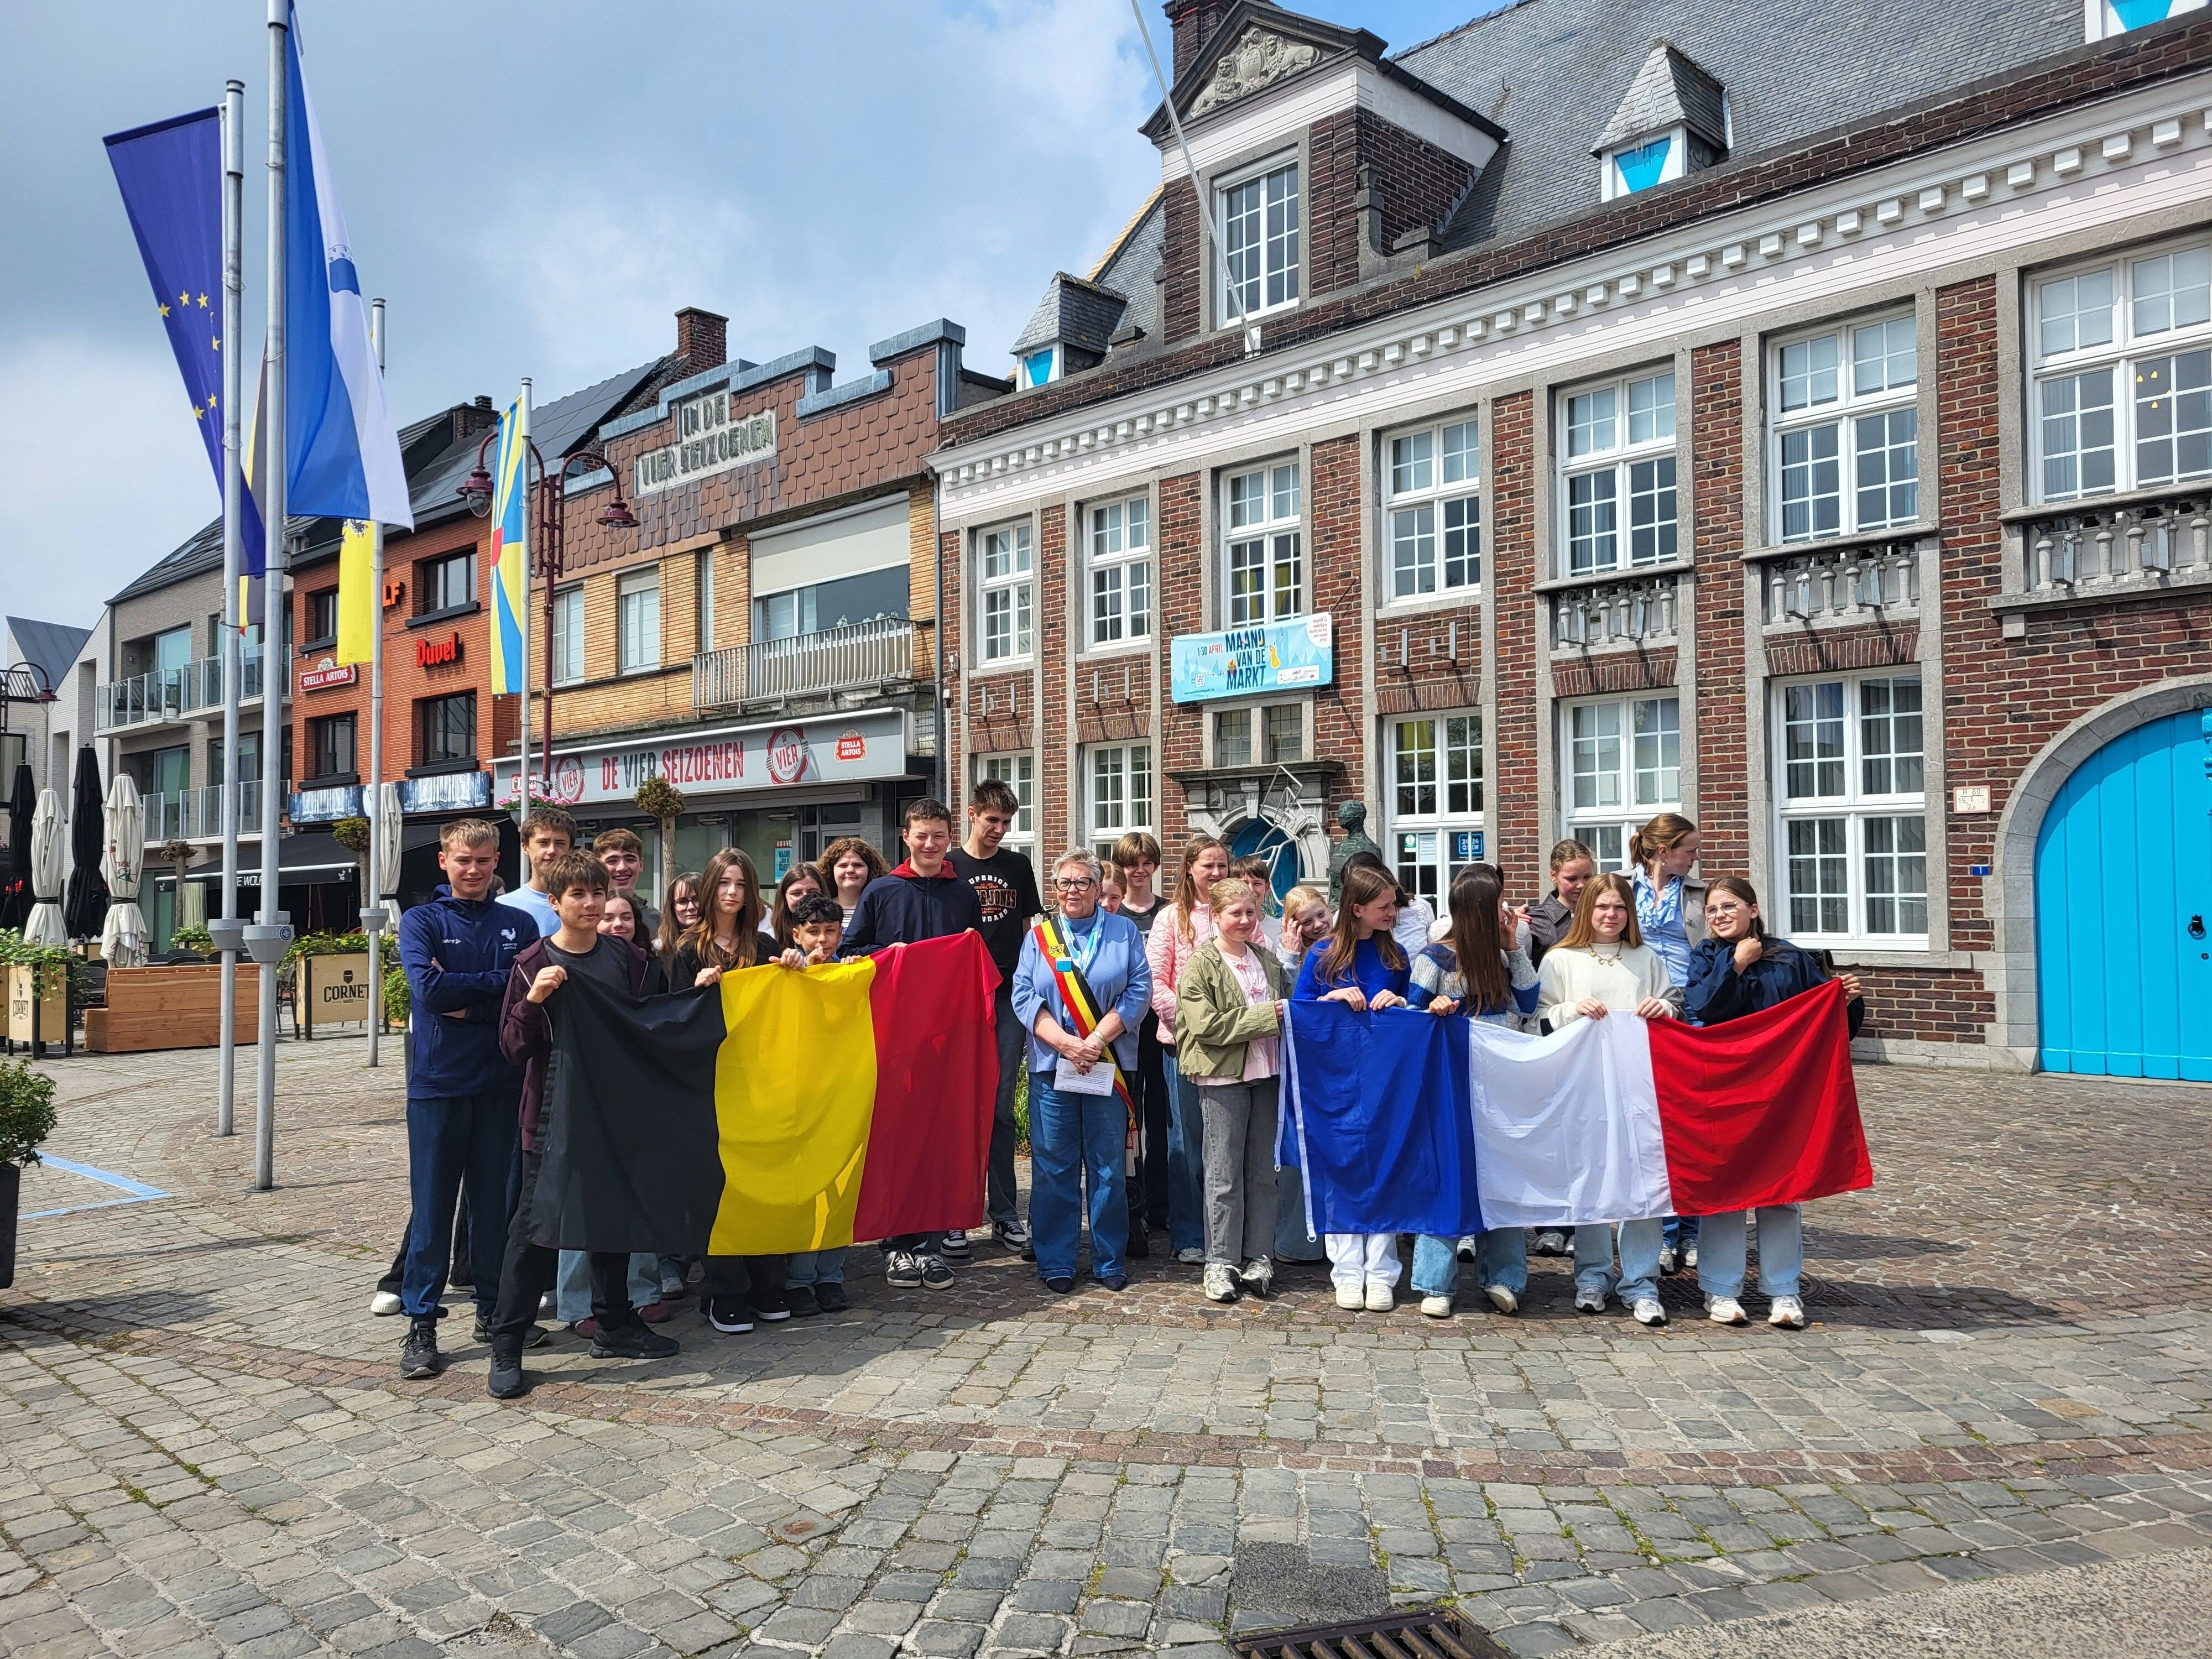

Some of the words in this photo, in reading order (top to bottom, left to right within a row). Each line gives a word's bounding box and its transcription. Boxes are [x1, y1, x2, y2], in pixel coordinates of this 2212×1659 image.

[684, 403, 701, 436] IN
[703, 394, 726, 429] DE
[641, 449, 677, 486] VIER
[680, 415, 774, 474] SEIZOENEN
[382, 581, 400, 607] LF
[416, 632, 456, 667] Duvel
[1197, 646, 1207, 656] 1-30
[1208, 644, 1223, 654] APRIL
[1225, 628, 1265, 653] MAAND
[1236, 649, 1253, 667] VAN
[1255, 649, 1266, 665] DE
[303, 674, 325, 686] STELLA
[326, 669, 348, 682] ARTOIS
[1226, 665, 1266, 691] MARKT
[782, 733, 787, 744] DE
[841, 740, 861, 749] STELLA
[775, 743, 799, 770] VIER
[841, 748, 862, 757] ARTOIS
[602, 757, 619, 791] DE
[623, 752, 656, 788] VIER
[662, 740, 744, 784] SEIZOENEN
[561, 769, 578, 792] VIER
[968, 875, 1008, 889] UPERIOR
